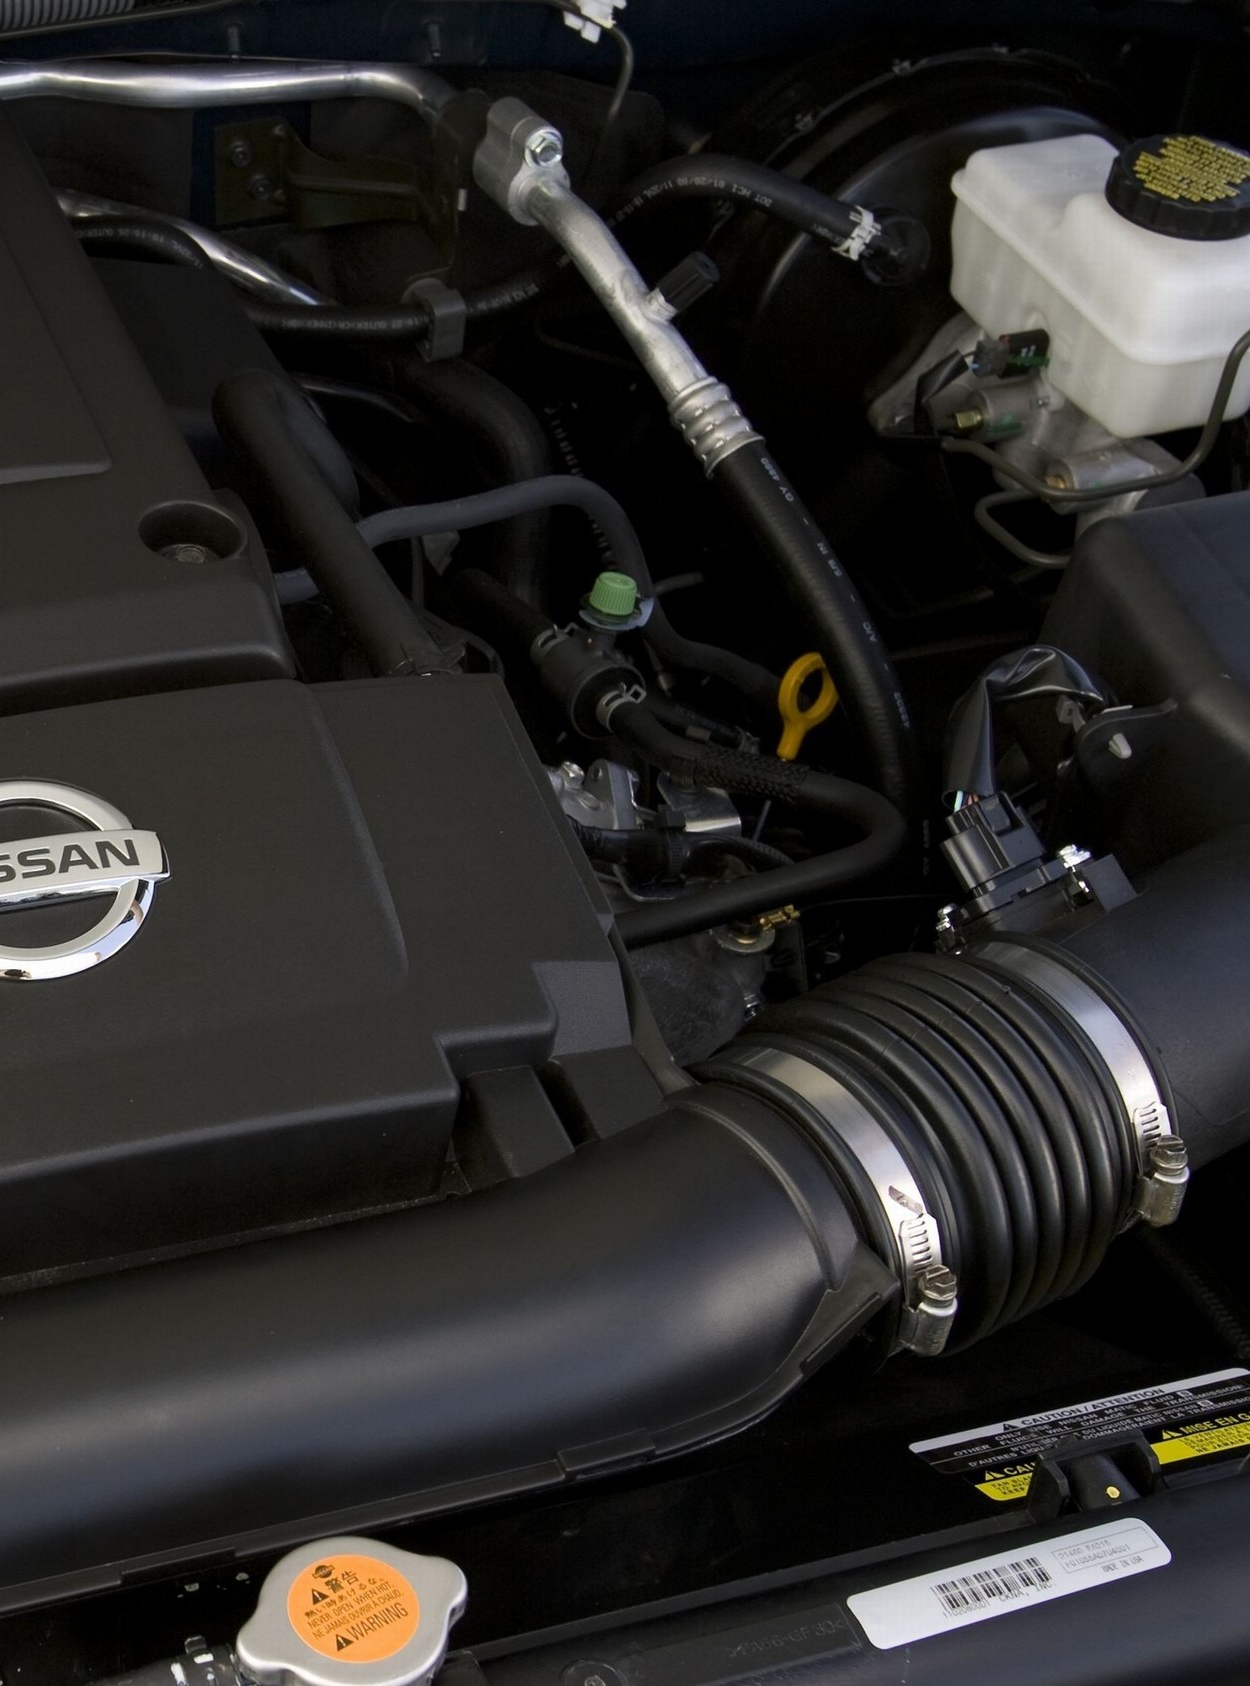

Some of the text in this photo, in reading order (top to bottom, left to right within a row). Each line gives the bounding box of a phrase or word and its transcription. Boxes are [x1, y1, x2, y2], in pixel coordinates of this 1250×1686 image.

[1021, 1407, 1081, 1426] CAUTION
[1091, 1388, 1165, 1410] ATTENTION
[1179, 1421, 1218, 1434] MISE
[1215, 1416, 1239, 1426] EN
[953, 1444, 991, 1457] OTHER
[307, 1613, 333, 1628] NEVER
[333, 1602, 354, 1617] OPEN
[353, 1590, 378, 1606] WHEN
[346, 1602, 408, 1641] WARNING
